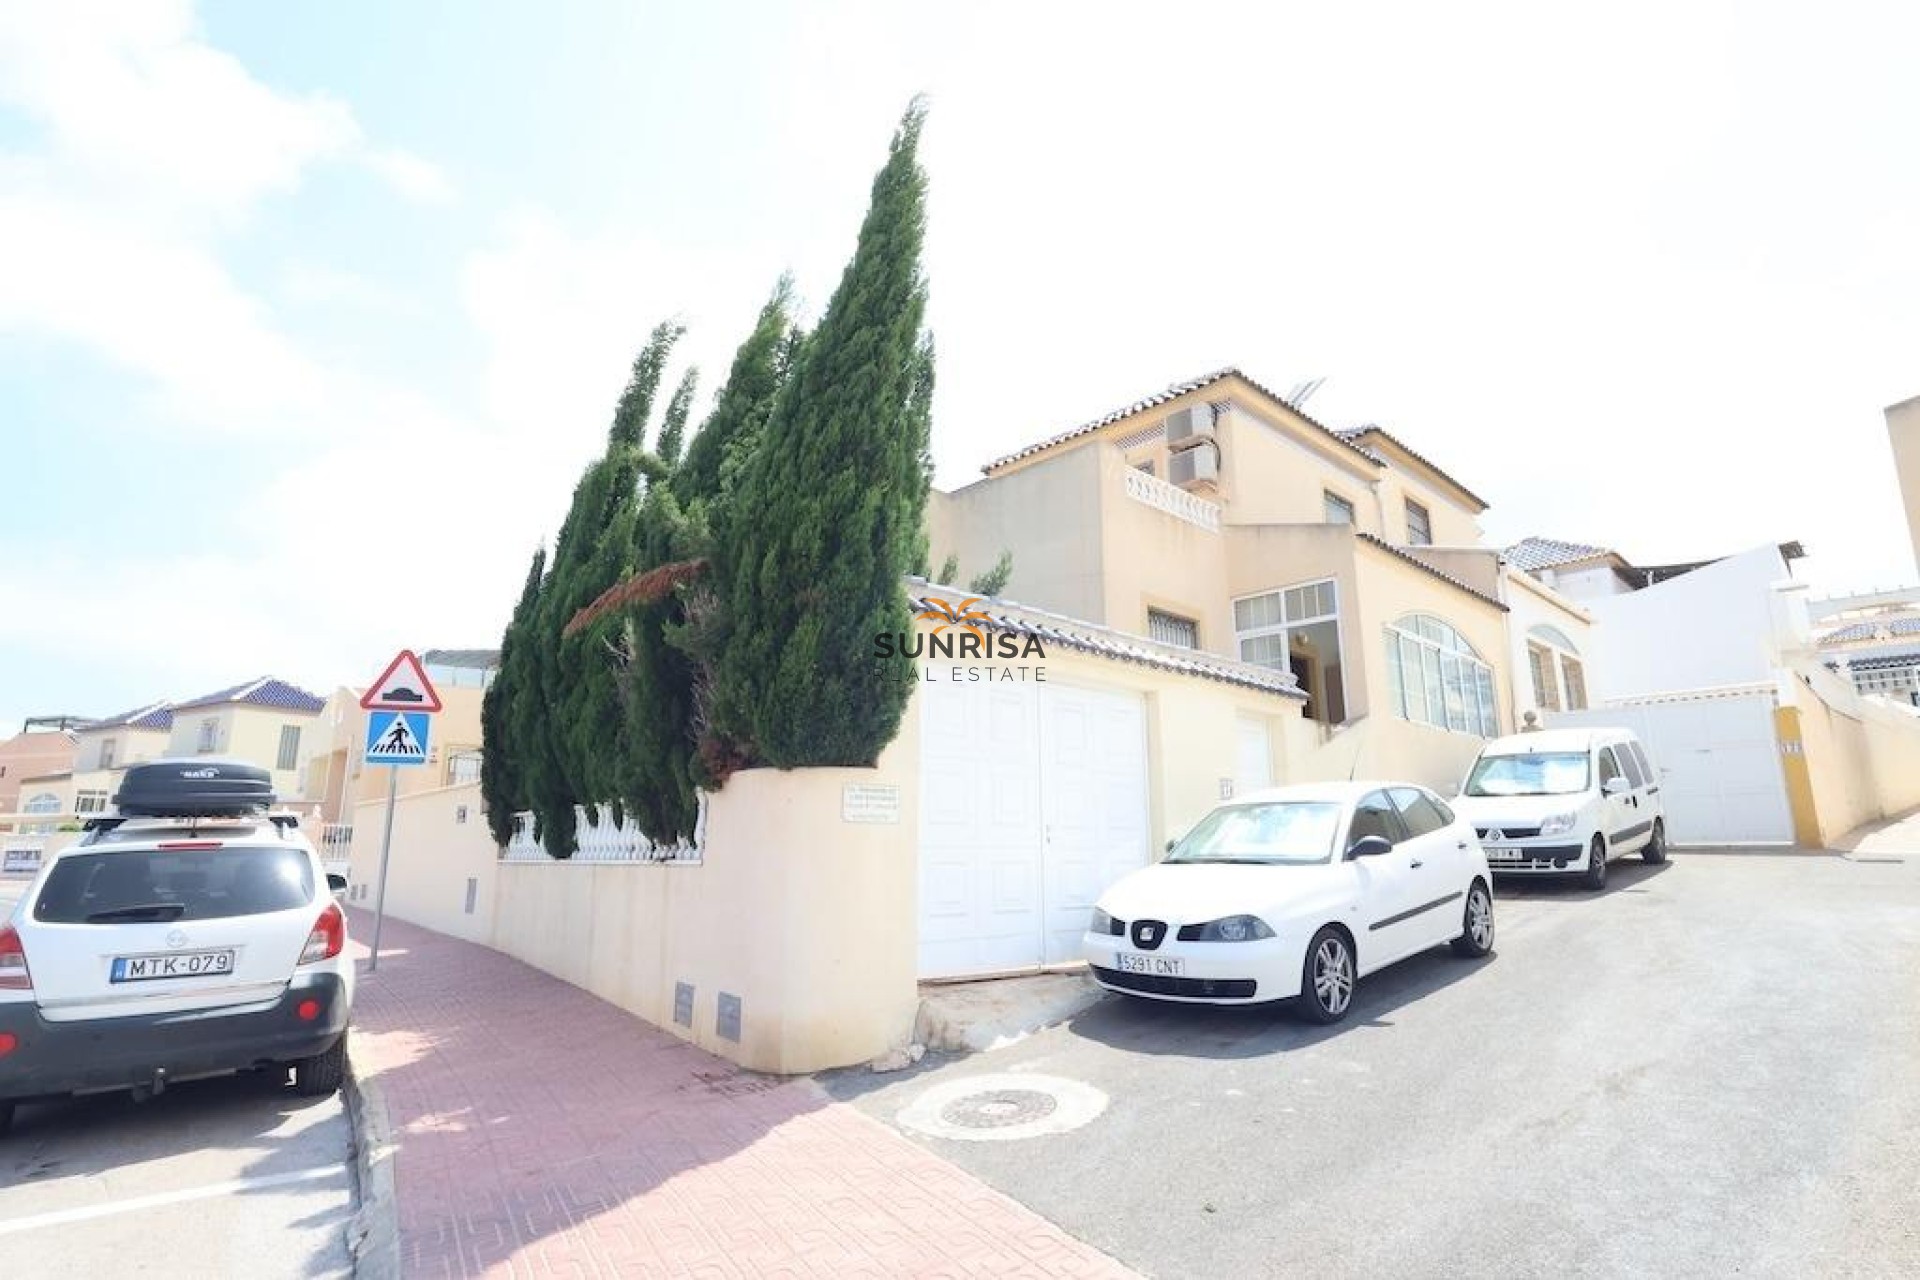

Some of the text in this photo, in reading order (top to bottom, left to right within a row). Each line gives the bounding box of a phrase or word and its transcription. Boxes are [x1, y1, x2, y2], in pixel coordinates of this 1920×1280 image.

[130, 955, 228, 976] MTK-079
[1124, 955, 1179, 975] 5291 CNT
